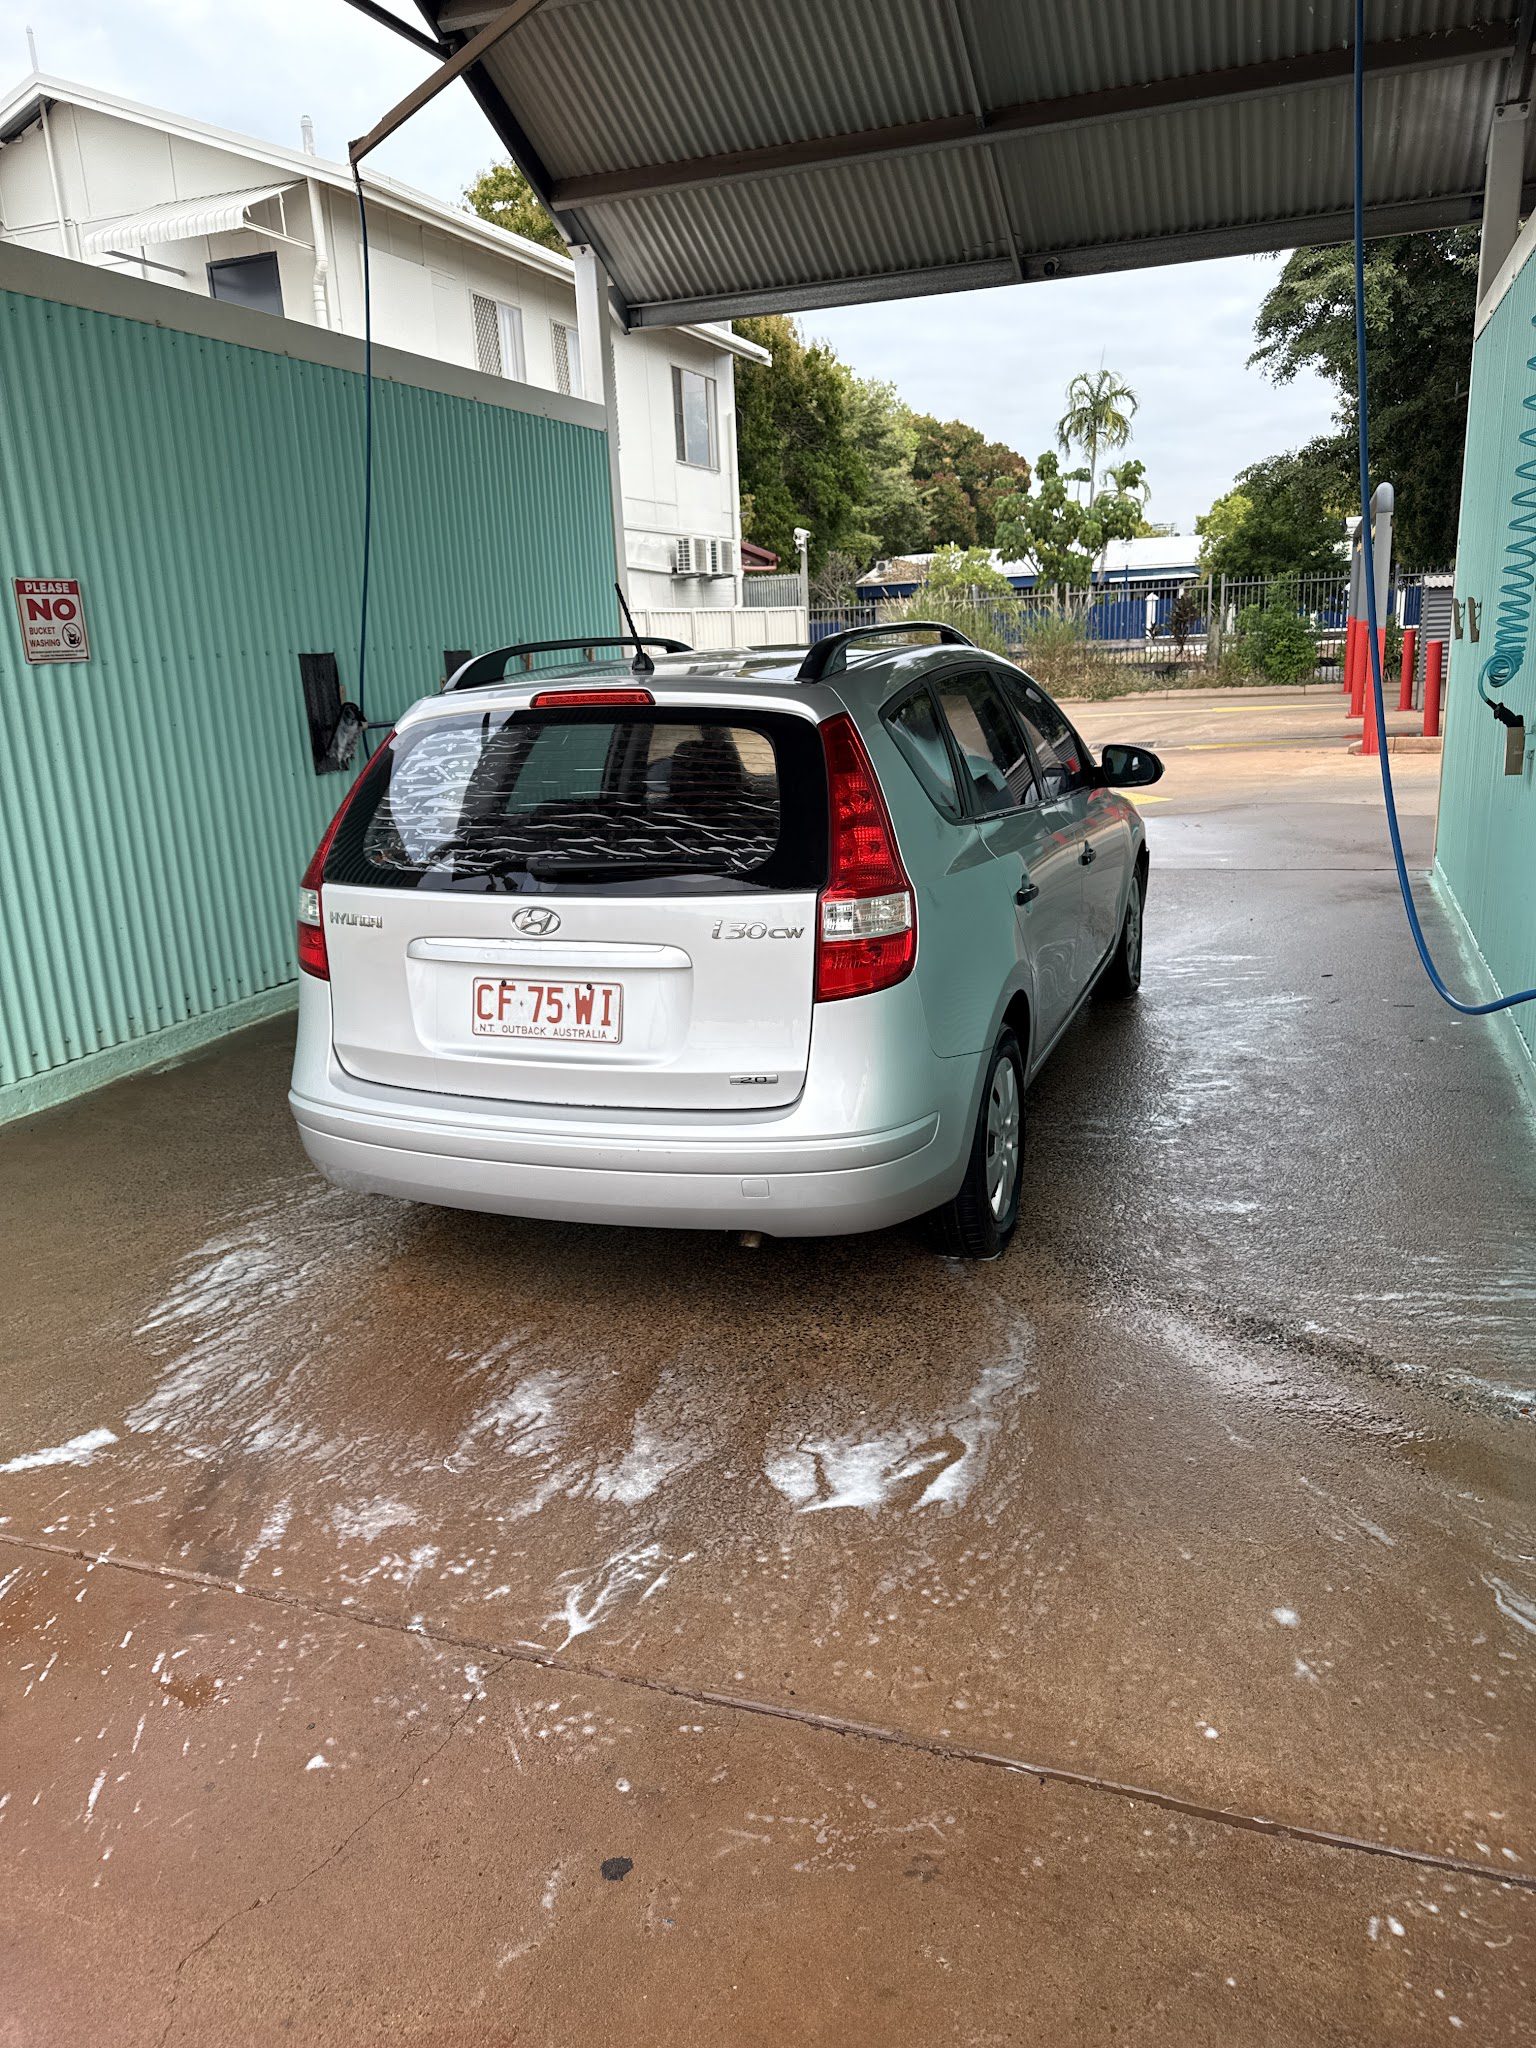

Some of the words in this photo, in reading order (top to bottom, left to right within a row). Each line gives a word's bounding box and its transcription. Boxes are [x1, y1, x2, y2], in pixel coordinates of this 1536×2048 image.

[25, 582, 70, 593] PLEASE
[26, 598, 77, 621] NO
[29, 626, 56, 636] BUCKET
[30, 638, 61, 648] WASHING
[501, 1025, 547, 1036] OUTBACK
[552, 1029, 607, 1039] AUSTRALIA
